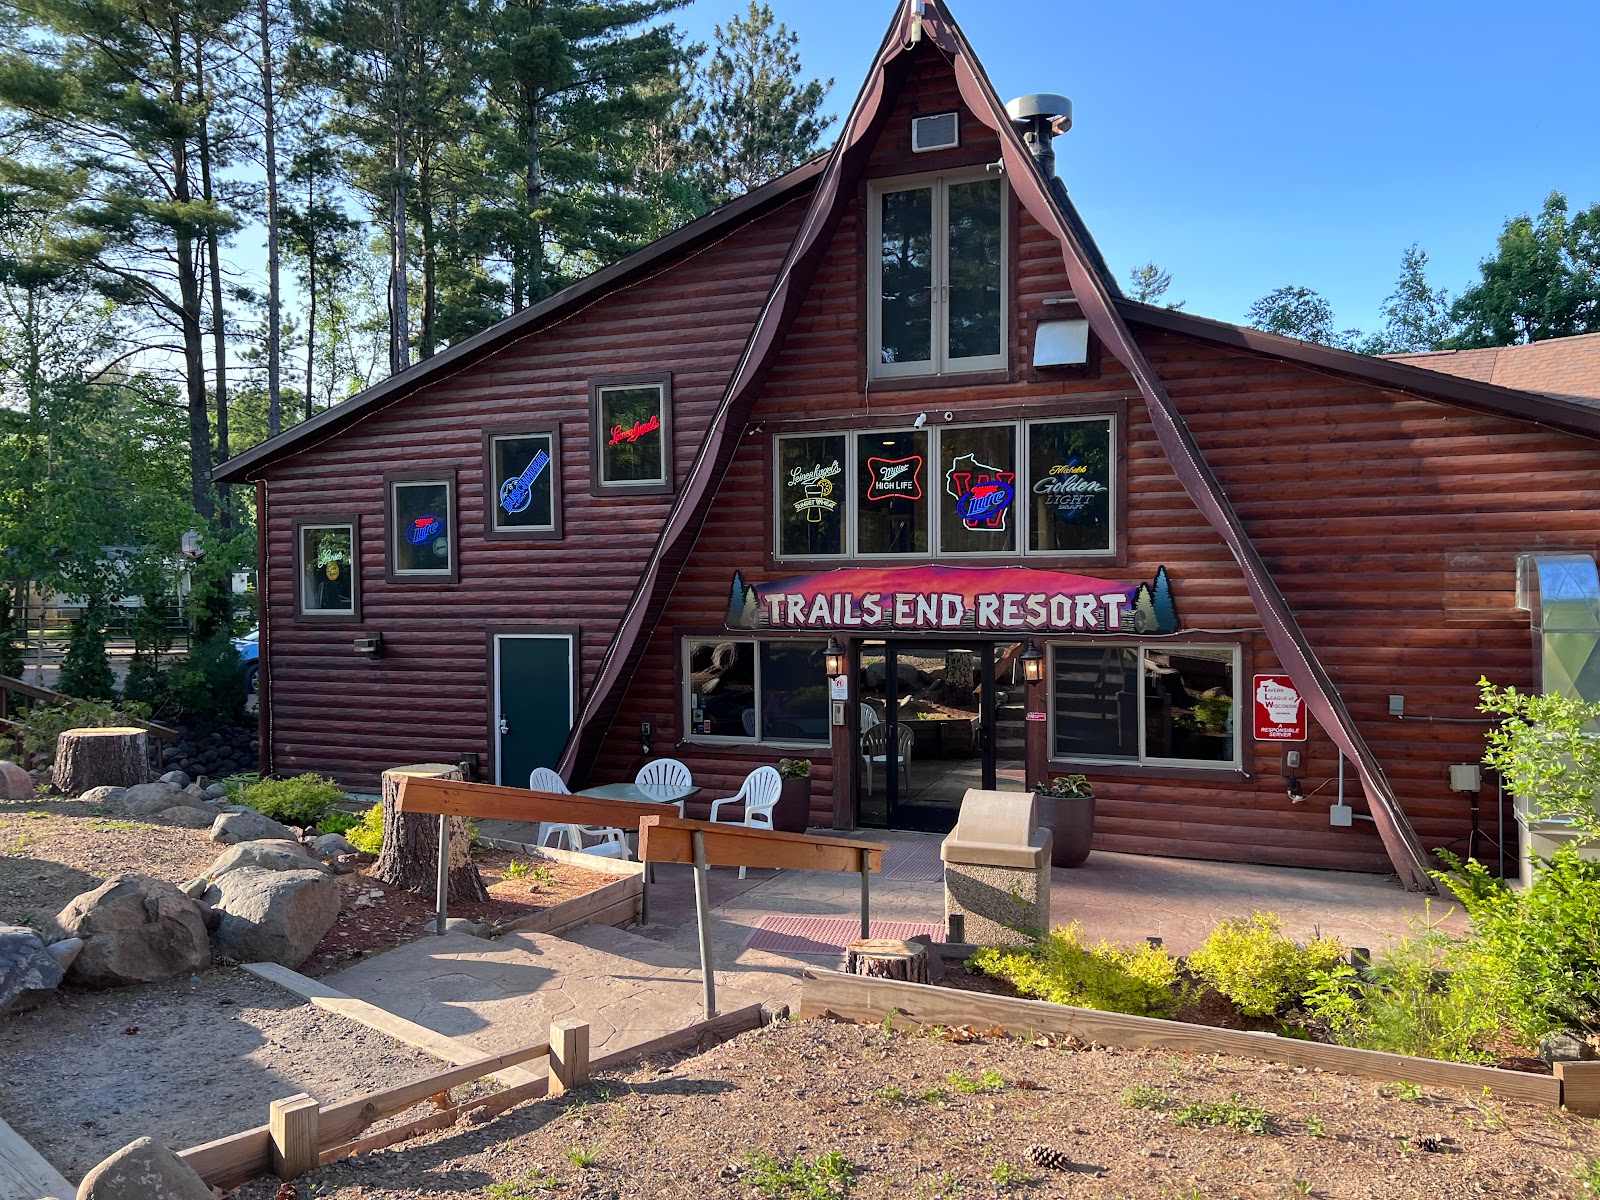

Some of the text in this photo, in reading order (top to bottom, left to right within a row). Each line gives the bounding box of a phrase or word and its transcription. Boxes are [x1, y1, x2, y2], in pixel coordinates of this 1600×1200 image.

[880, 464, 909, 481] Miller
[875, 481, 913, 490] HIGH LIFE
[1032, 474, 1108, 494] Golden
[1044, 494, 1095, 505] LIGHT
[764, 592, 1127, 630] TRAILS END RESORT
